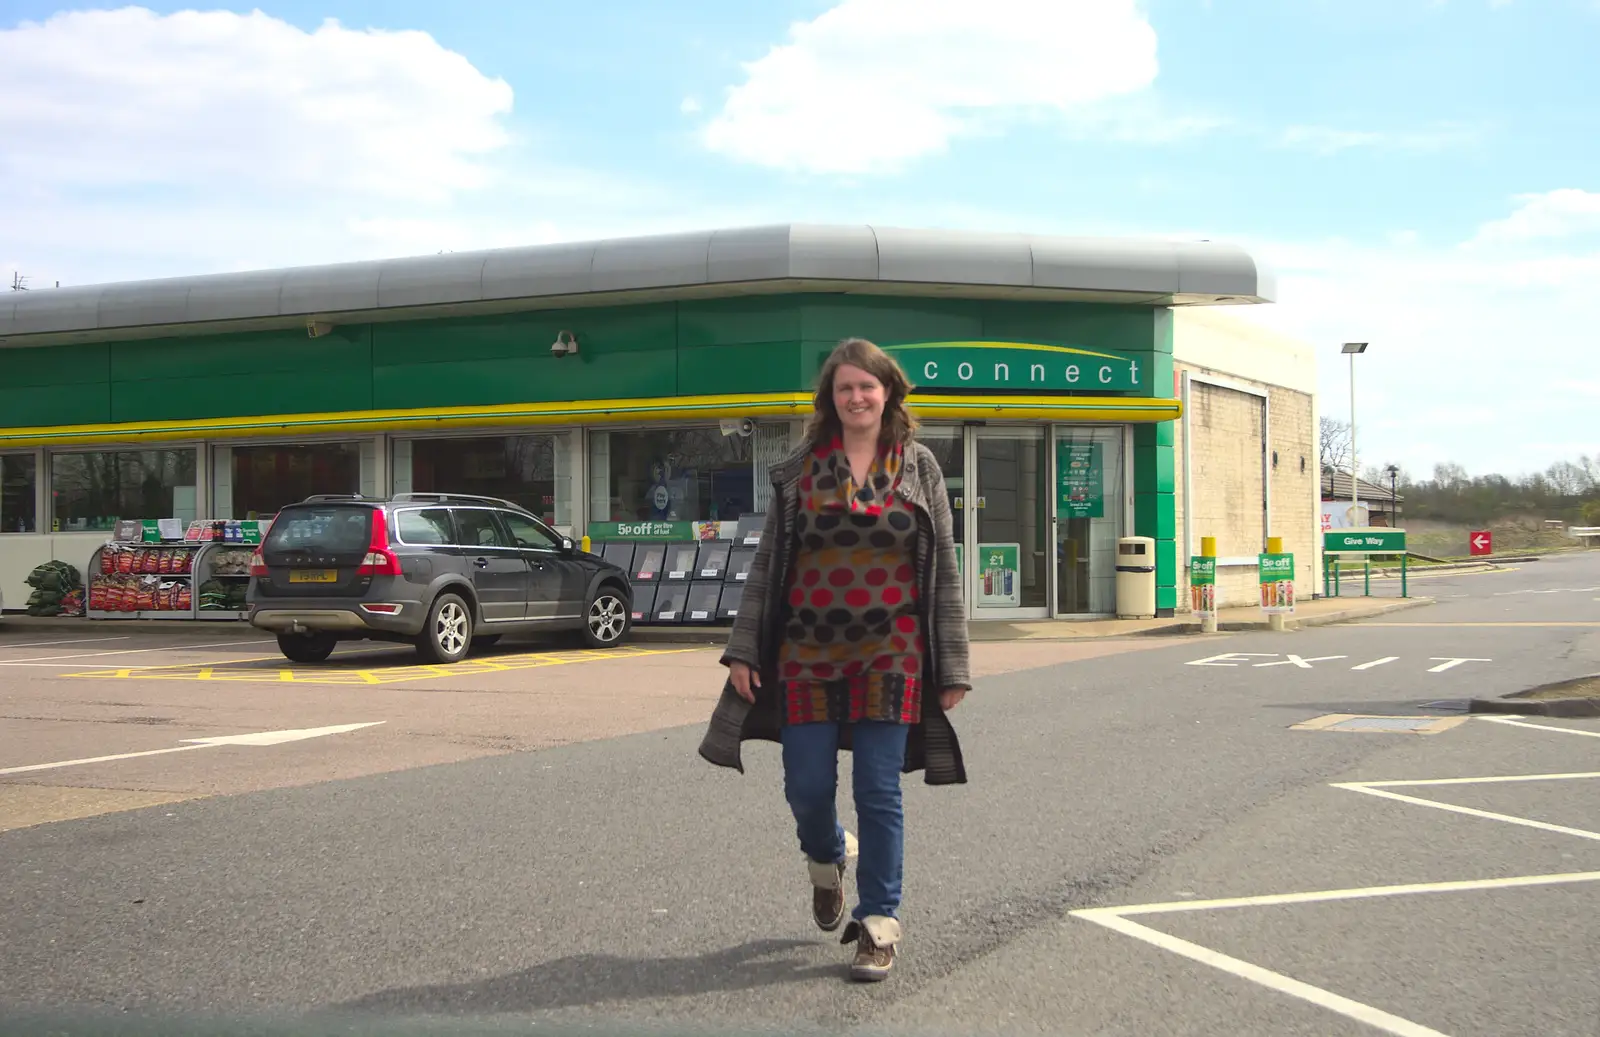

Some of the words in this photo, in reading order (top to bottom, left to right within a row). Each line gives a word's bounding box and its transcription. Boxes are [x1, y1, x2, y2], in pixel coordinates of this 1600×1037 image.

[924, 361, 1138, 384] connect
[618, 523, 632, 535] 5p
[633, 522, 652, 535] off
[1344, 537, 1363, 546] Give
[1365, 537, 1384, 547] Way
[990, 555, 1004, 566] £1
[1201, 561, 1214, 570] off
[1262, 558, 1274, 568] 5p
[1275, 557, 1290, 567] off
[1184, 653, 1492, 673] EXIT
